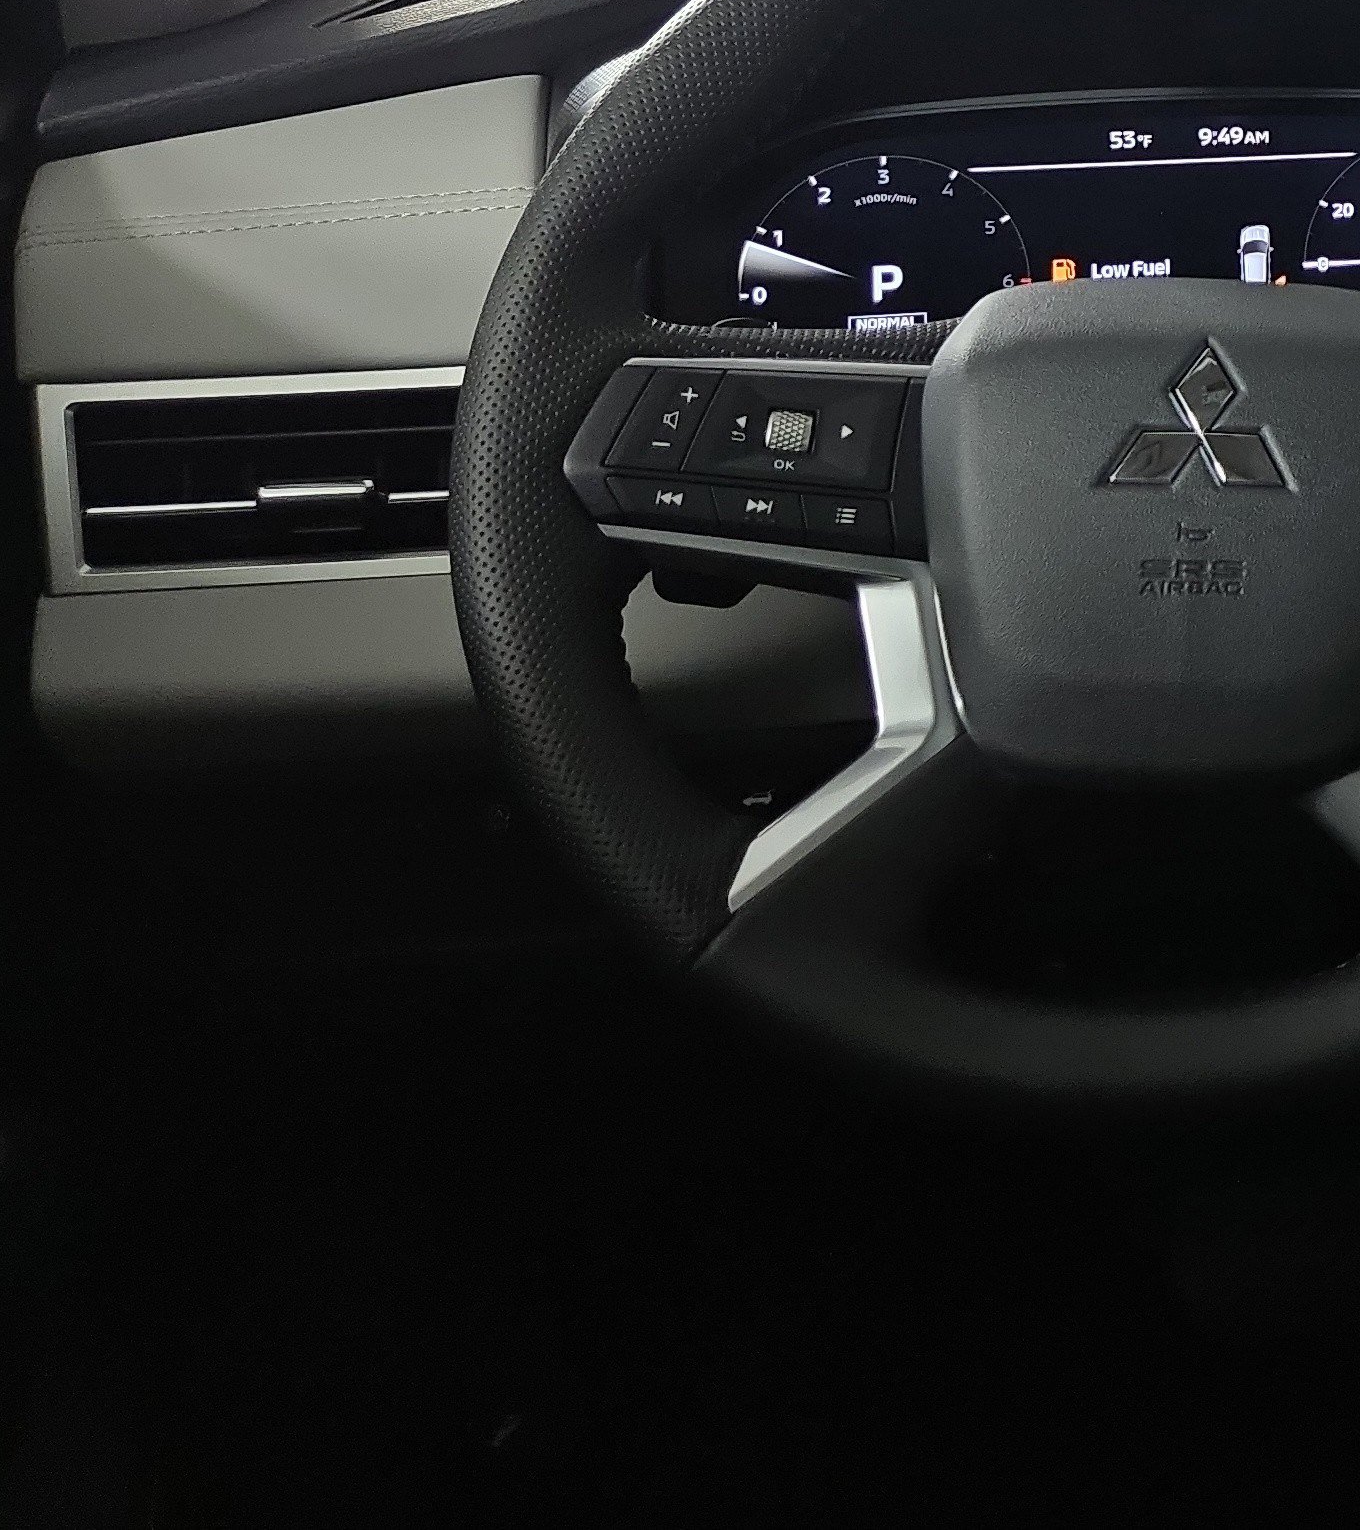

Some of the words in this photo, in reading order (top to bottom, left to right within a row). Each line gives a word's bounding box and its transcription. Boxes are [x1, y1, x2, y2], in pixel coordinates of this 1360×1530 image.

[877, 168, 890, 185] 3
[817, 186, 832, 204] 2
[941, 182, 955, 198] 4
[1331, 202, 1355, 220] 20
[984, 219, 996, 235] 5
[772, 229, 784, 247] 1
[1091, 262, 1130, 280] Low
[1132, 258, 1171, 278] Fuel
[870, 264, 903, 304] P
[1003, 273, 1015, 289] 6
[752, 286, 768, 305] 0
[855, 315, 915, 330] NORMAL
[773, 458, 796, 471] OK
[1138, 558, 1248, 579] SRS
[1138, 580, 1246, 597] AIRBAG
